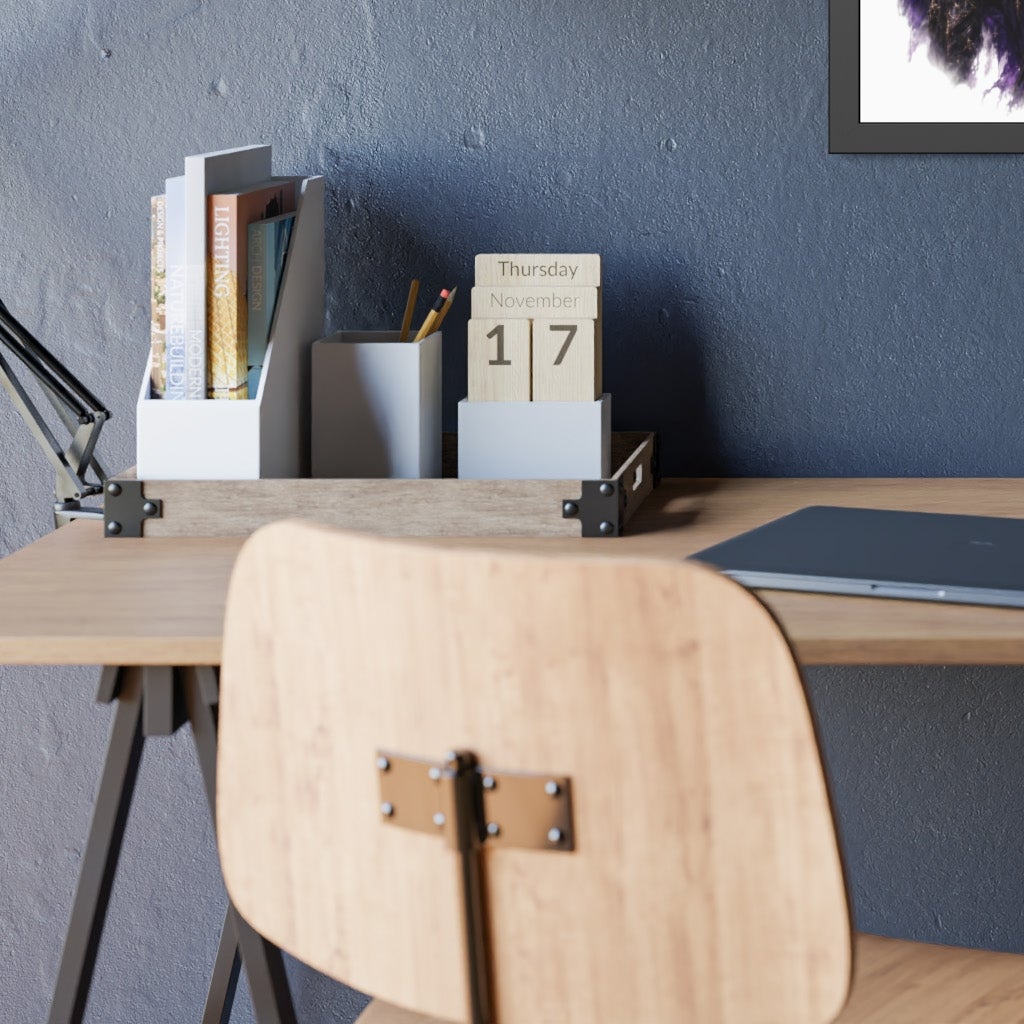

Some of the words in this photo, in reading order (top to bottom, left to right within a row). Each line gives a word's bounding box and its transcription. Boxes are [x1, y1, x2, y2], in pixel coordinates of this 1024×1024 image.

[156, 201, 165, 229] DESIGN
[213, 206, 230, 299] LIGHTING
[498, 261, 578, 280] Thursday
[252, 266, 263, 311] DESIGN
[490, 293, 580, 308] November
[189, 330, 202, 399] MODERN
